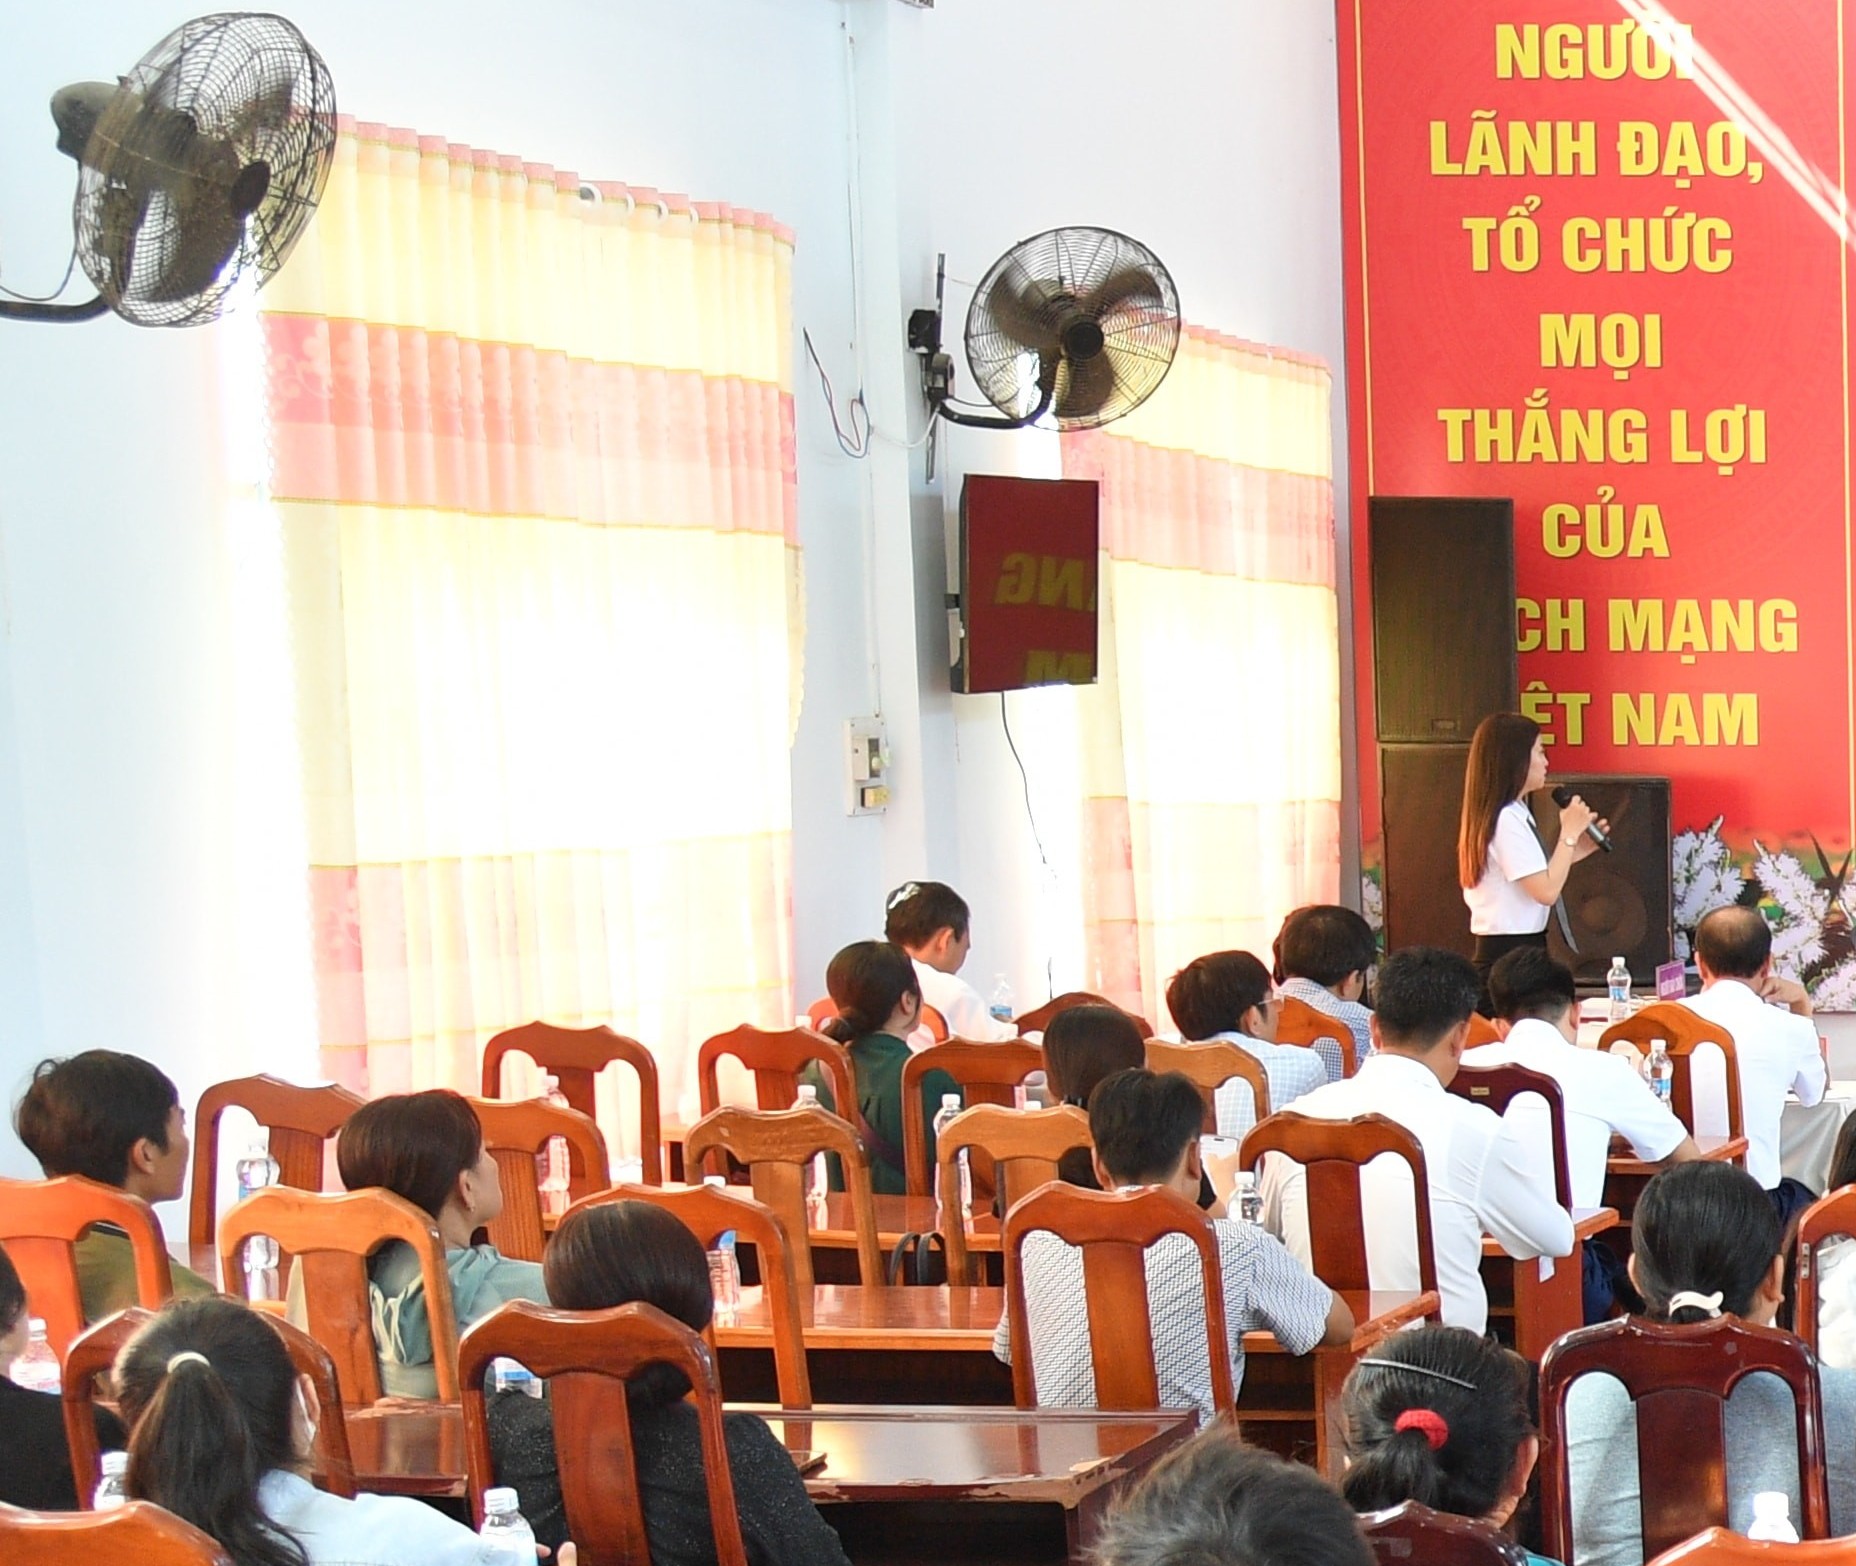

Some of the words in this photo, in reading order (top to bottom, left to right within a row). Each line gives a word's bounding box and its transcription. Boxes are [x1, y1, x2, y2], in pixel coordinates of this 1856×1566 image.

[1428, 109, 1598, 177] LÃNH
[1616, 120, 1765, 189] ĐẠO,
[1462, 195, 1542, 273] TỔ
[1562, 205, 1734, 273] CHỨC
[1540, 313, 1663, 380] MỌI
[1437, 387, 1649, 464] THẮNG
[1670, 403, 1767, 476] LỢI
[1541, 485, 1671, 558] CỦA
[1608, 597, 1799, 664] MẠNG
[1612, 692, 1760, 747] NAM
